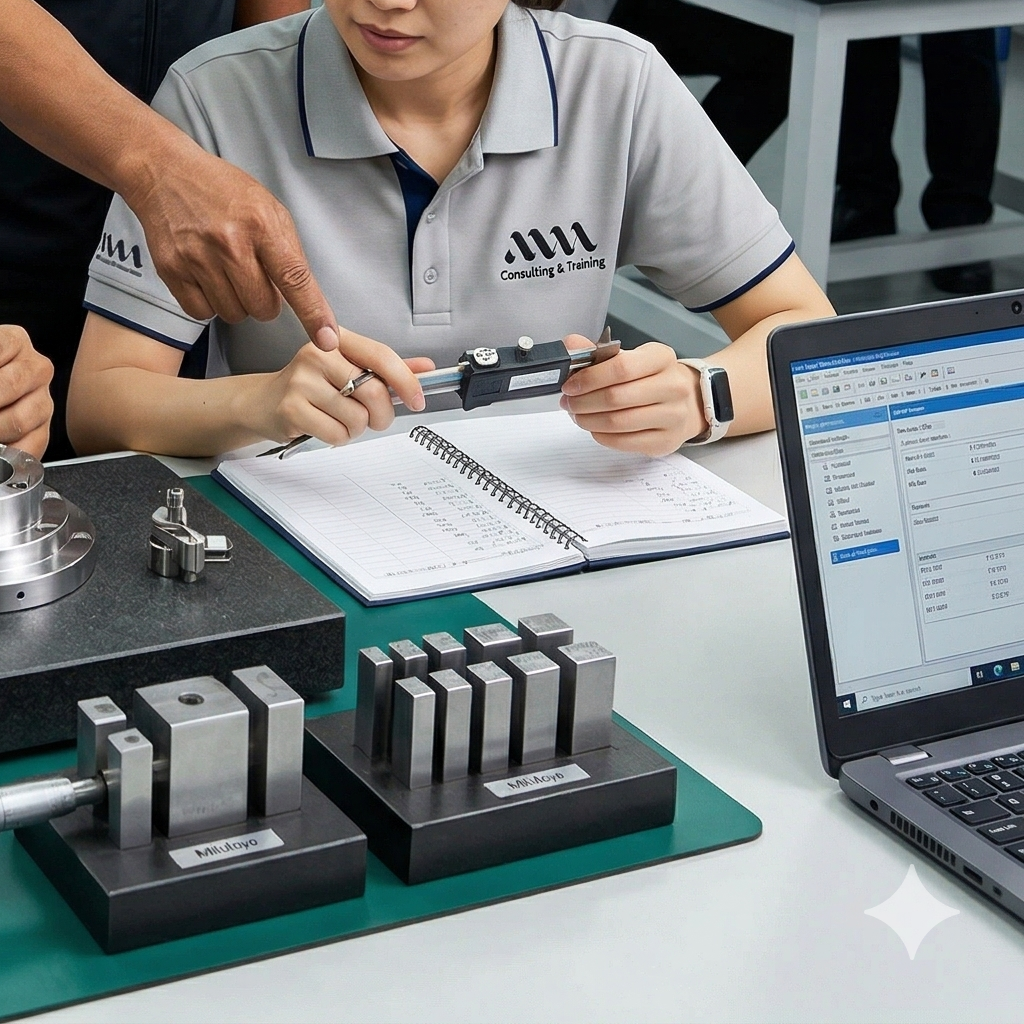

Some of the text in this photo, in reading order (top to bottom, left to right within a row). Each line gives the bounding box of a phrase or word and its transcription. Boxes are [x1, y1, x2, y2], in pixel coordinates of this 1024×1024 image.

[500, 256, 606, 280] Consulting & Training
